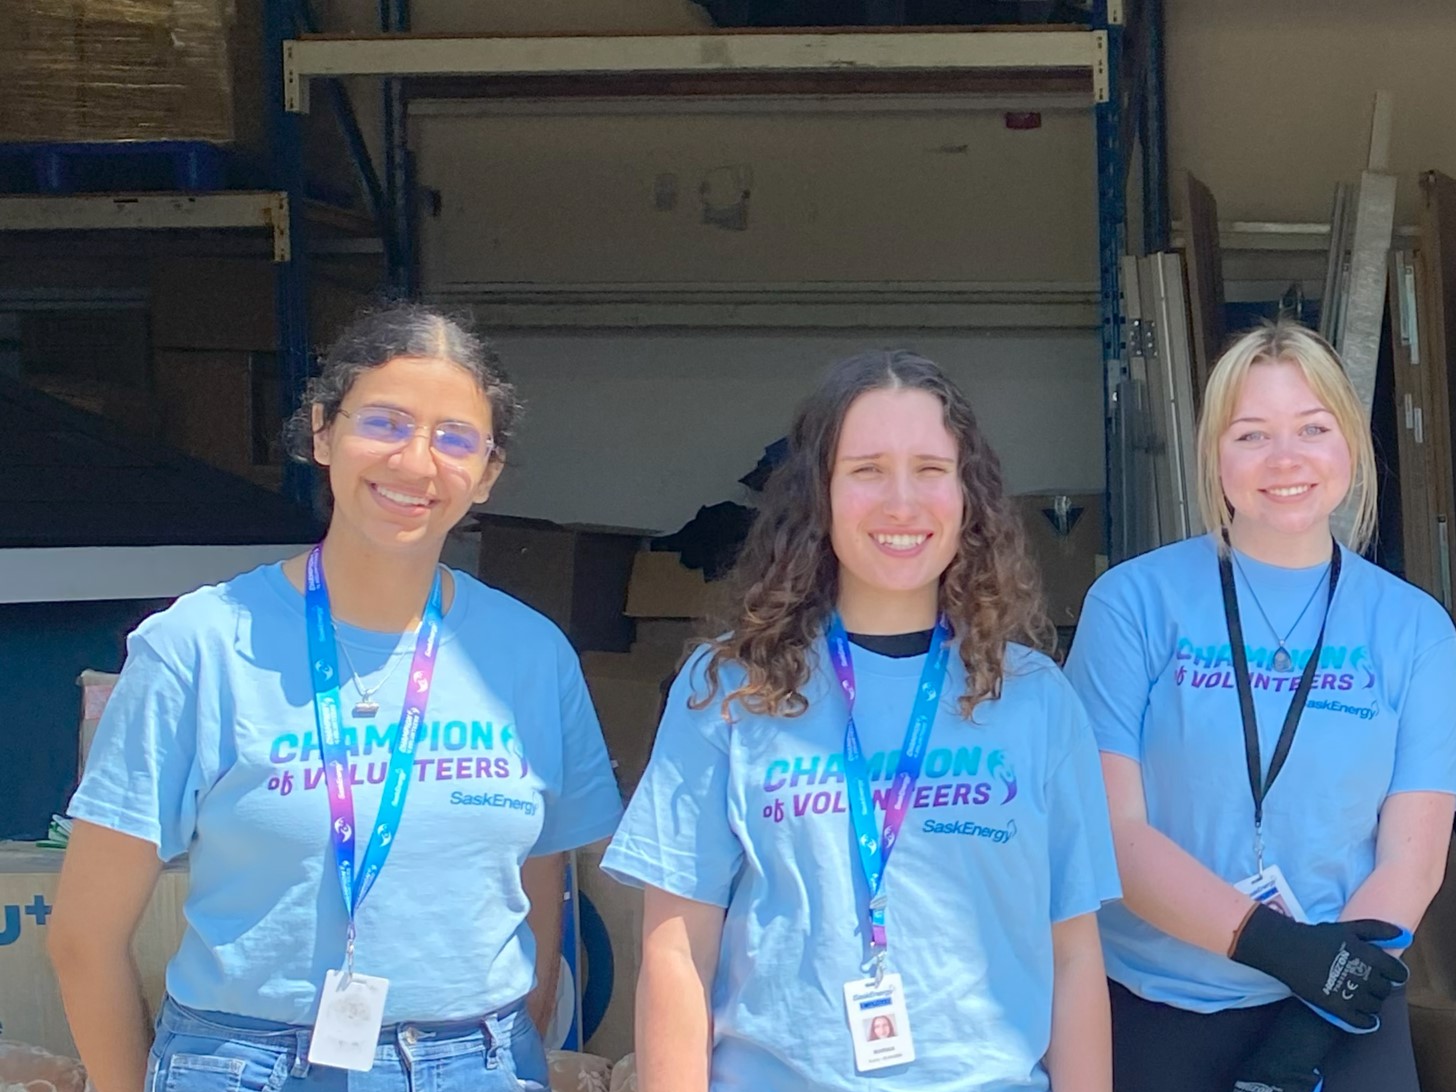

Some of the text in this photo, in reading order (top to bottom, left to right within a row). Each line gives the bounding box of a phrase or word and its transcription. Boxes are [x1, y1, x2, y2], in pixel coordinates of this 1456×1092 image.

[1306, 699, 1376, 720] askEnergy
[268, 756, 510, 796] of VLUTEERS
[450, 791, 537, 816] SaskEnergy
[763, 782, 991, 822] of VOLNEERS
[922, 819, 1010, 843] SaskEnergy
